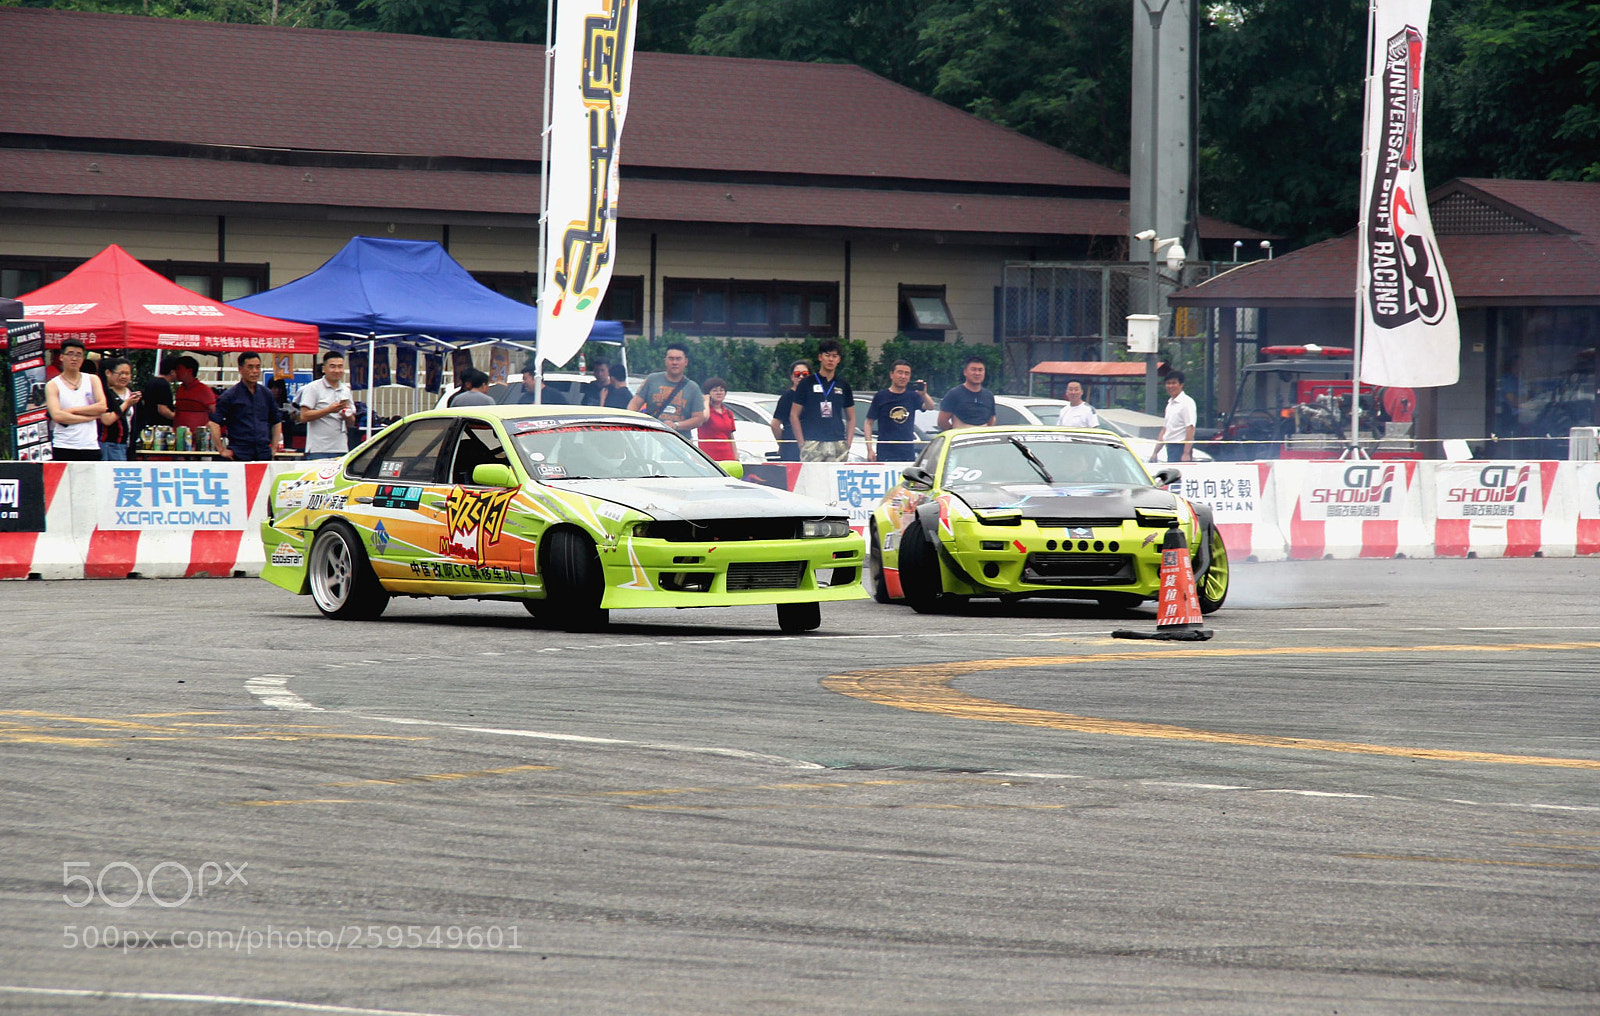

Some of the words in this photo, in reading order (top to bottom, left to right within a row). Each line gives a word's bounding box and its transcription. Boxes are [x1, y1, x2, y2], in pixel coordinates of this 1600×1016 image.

[1385, 61, 1407, 175] UNIVERSAL
[1372, 241, 1399, 316] RACING
[949, 466, 983, 482] 50
[1344, 465, 1380, 488] GT
[1480, 465, 1517, 488] GT
[113, 467, 230, 507] 爱卡汽车
[1185, 478, 1253, 498] 锐向轮毂
[1310, 488, 1371, 503] SHOW
[1446, 488, 1506, 503] SHOW
[116, 511, 231, 525] XCAR.COM.CN
[1327, 504, 1381, 517] 国际改装风尚秀
[1462, 504, 1516, 517] 国际改装风尚秀
